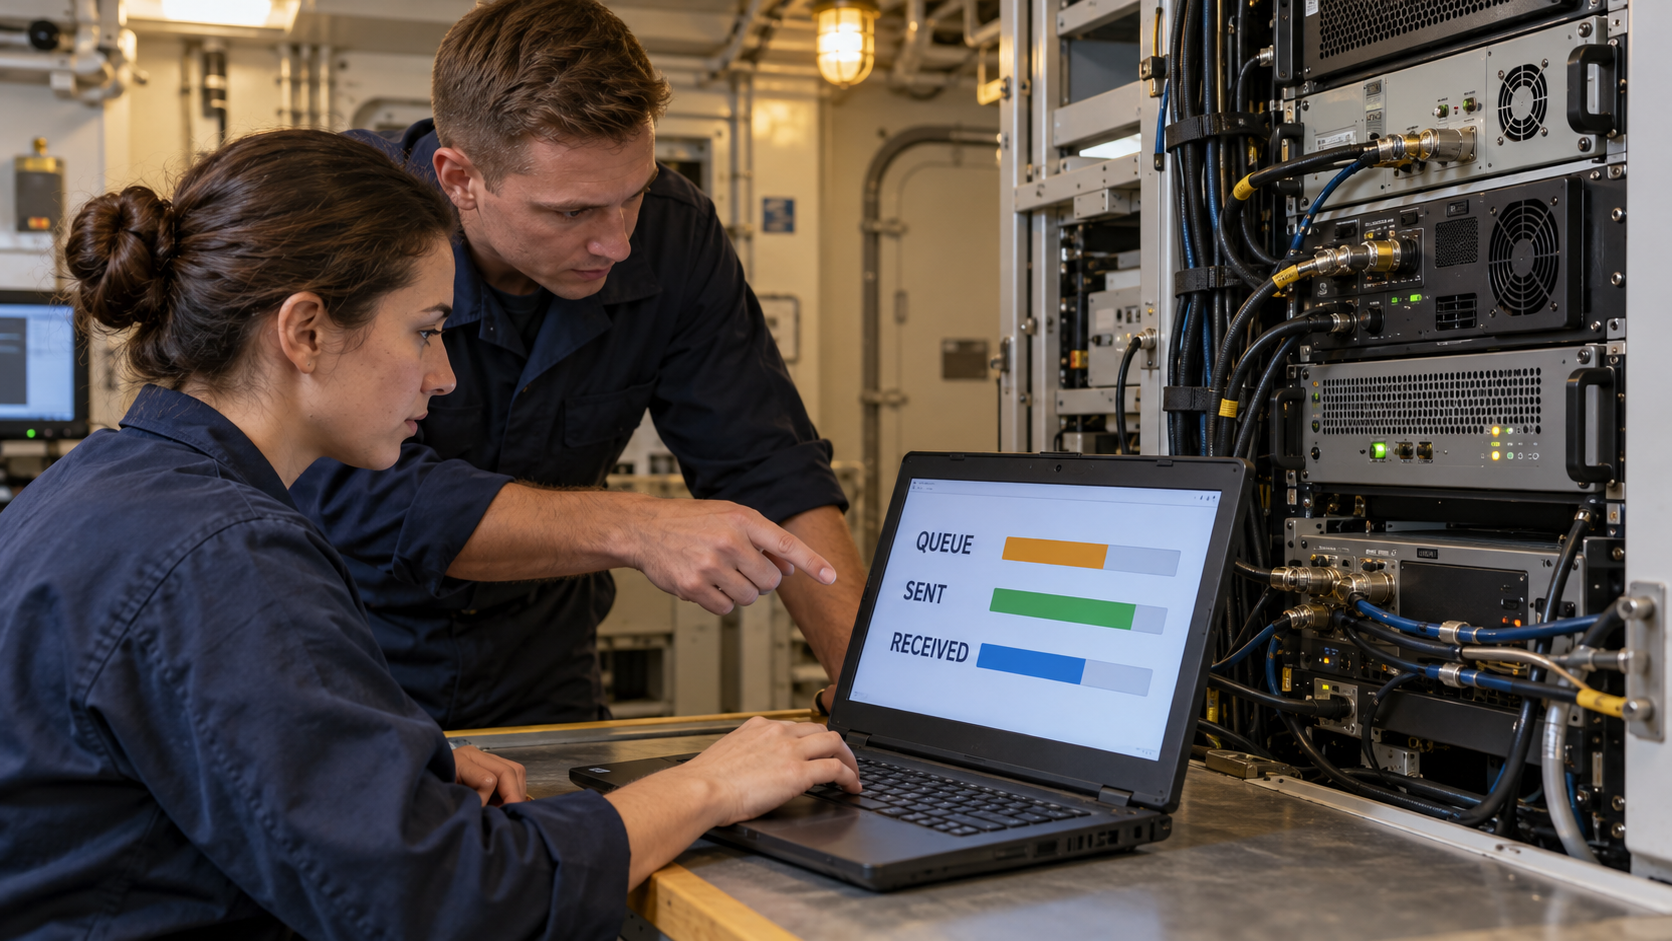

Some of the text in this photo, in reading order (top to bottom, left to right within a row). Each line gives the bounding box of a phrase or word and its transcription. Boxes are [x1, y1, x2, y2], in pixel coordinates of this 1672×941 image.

[916, 531, 975, 555] QUEUE
[903, 580, 947, 604] SENT
[890, 632, 969, 663] RECEIVED
